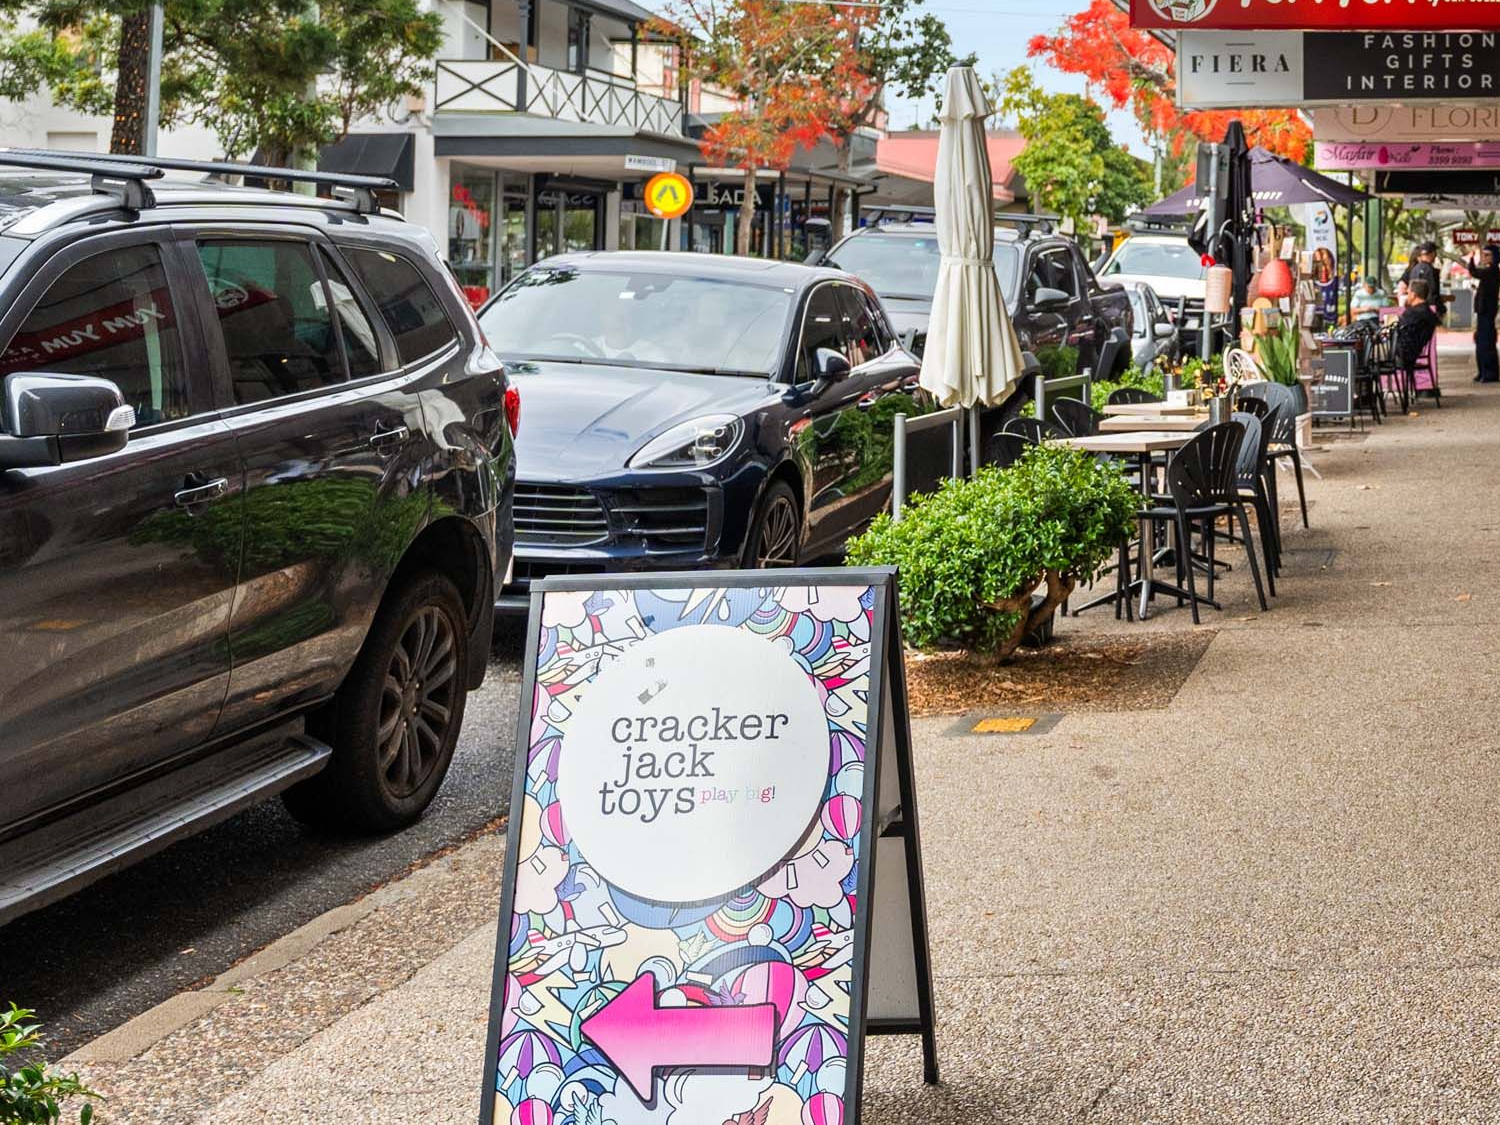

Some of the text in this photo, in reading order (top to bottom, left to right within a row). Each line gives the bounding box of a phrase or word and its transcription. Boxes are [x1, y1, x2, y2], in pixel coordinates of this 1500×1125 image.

[1364, 32, 1496, 50] FASHION
[1190, 53, 1291, 74] FIERA
[1386, 54, 1475, 70] GIFTS
[610, 707, 789, 744] cracker
[613, 744, 715, 787] jack
[599, 783, 776, 824] toys play big!
